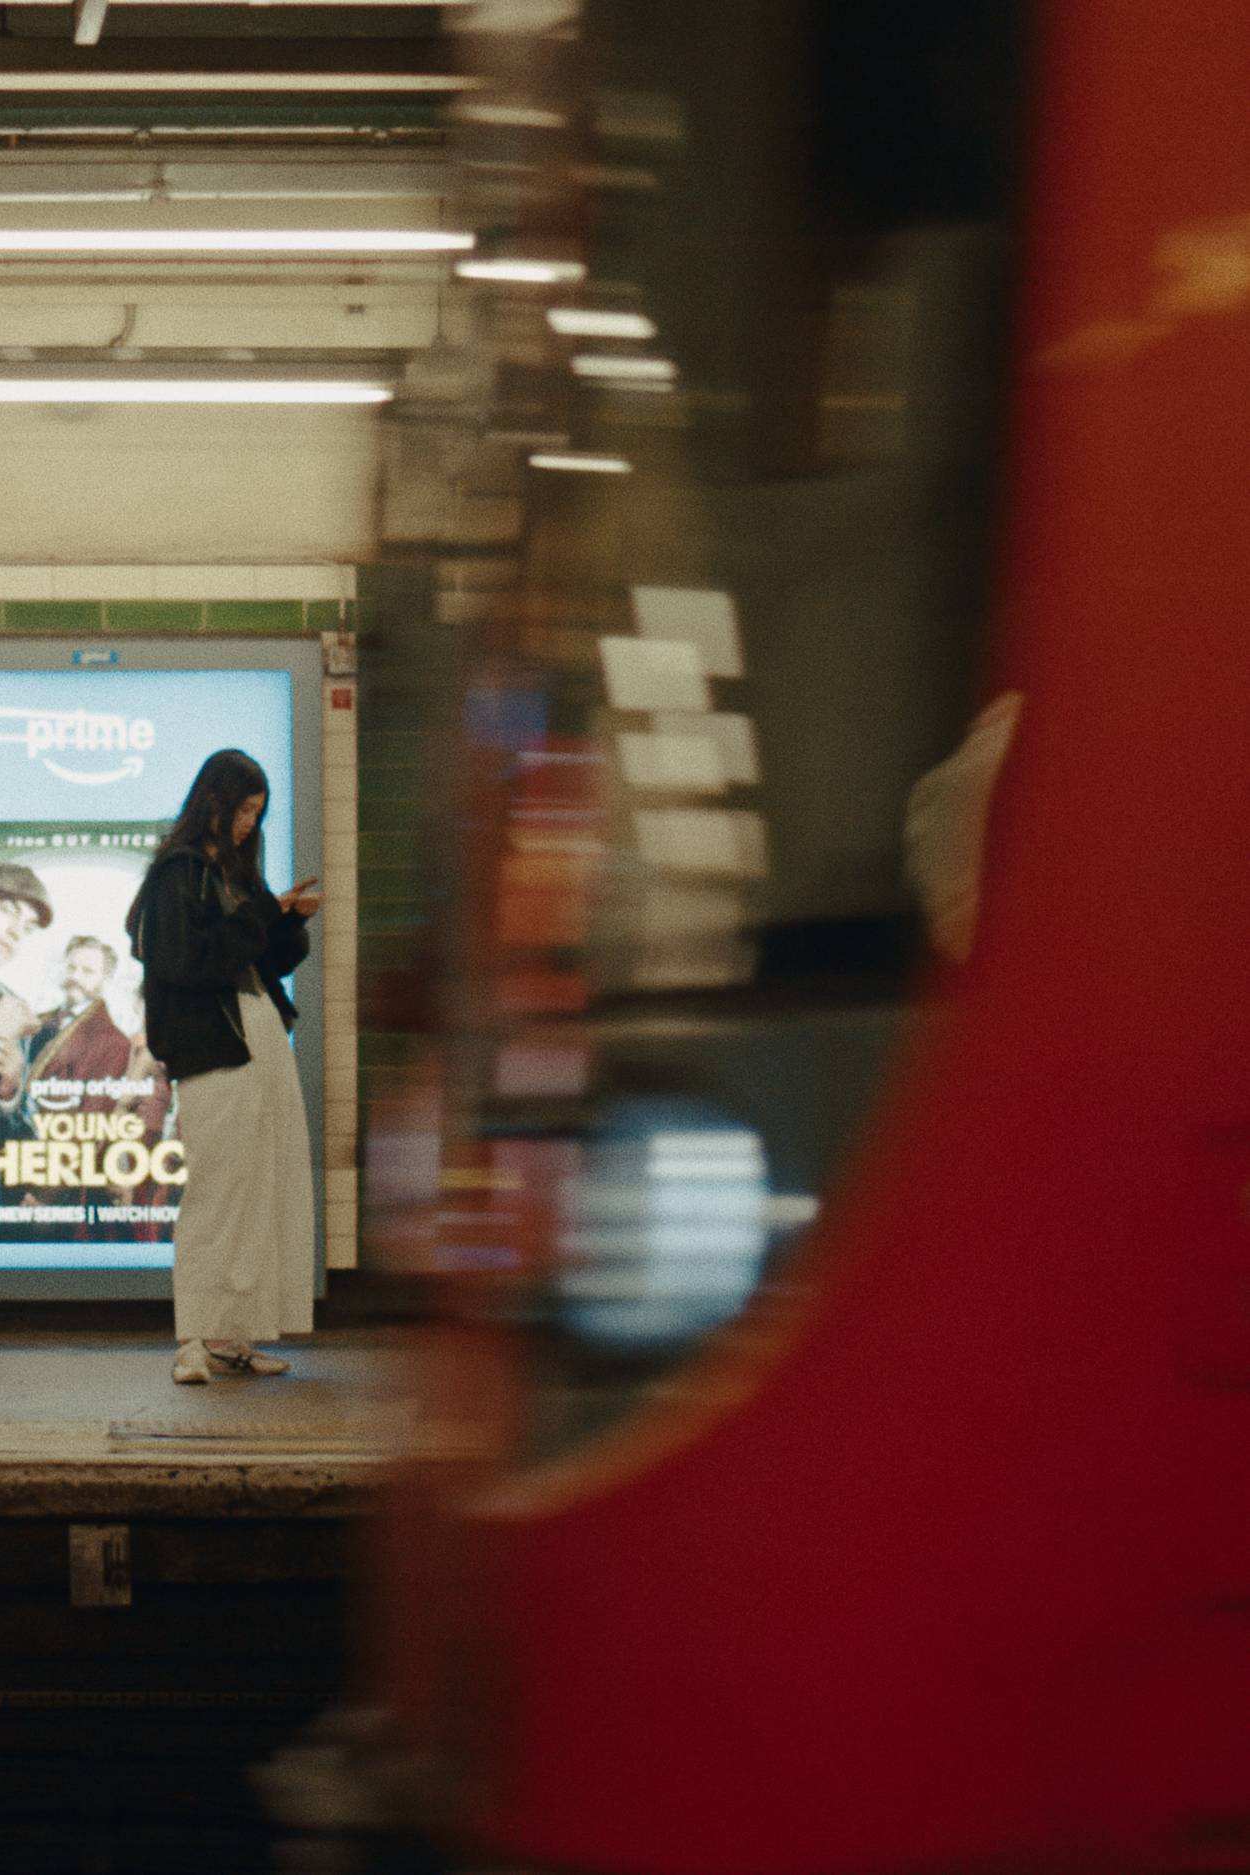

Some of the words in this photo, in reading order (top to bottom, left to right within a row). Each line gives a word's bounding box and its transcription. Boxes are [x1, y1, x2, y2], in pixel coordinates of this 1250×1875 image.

[27, 709, 154, 758] prime
[51, 834, 91, 847] GUY
[30, 1075, 85, 1099] prime
[86, 1075, 155, 1100] original
[32, 1112, 146, 1141] YOUNG
[34, 1206, 86, 1222] SERIES
[97, 1206, 149, 1222] WATCH
